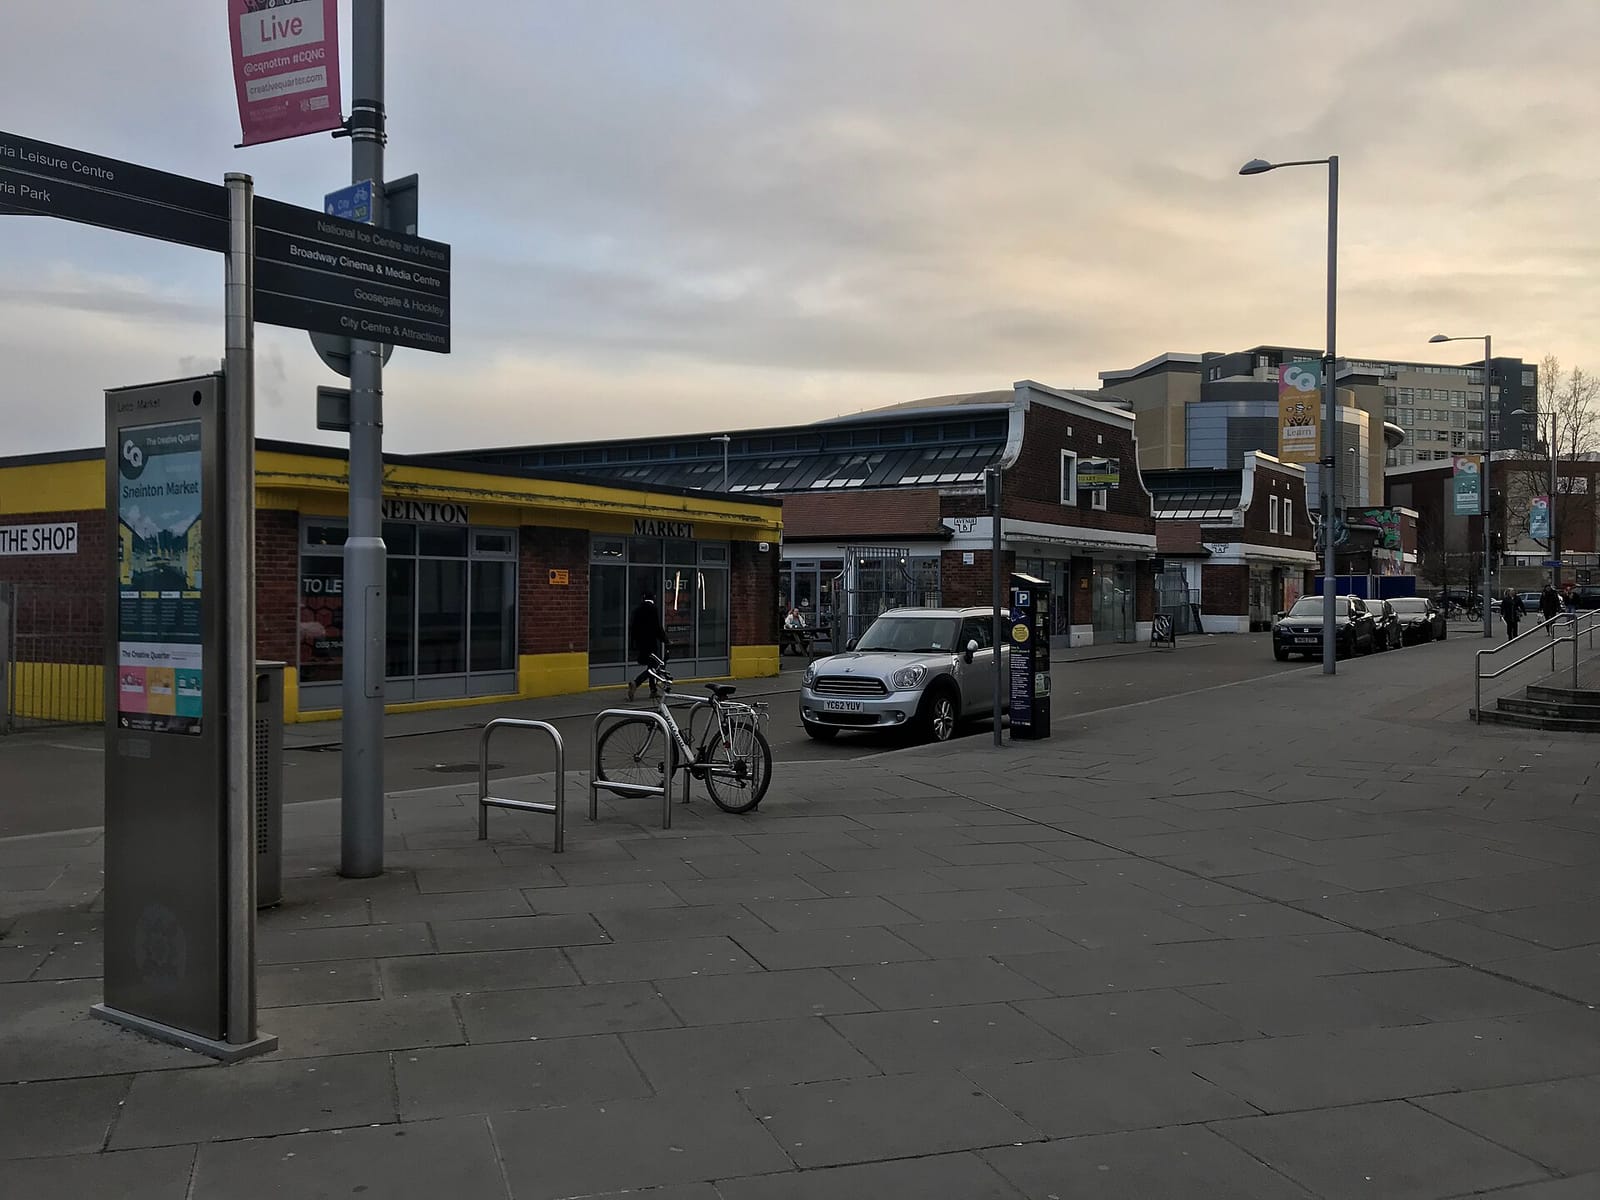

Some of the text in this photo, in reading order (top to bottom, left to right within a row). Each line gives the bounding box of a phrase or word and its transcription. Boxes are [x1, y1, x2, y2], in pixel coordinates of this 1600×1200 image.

[260, 15, 302, 42] Live
[244, 48, 325, 76] @cqnottm #CQNG
[249, 74, 323, 94] creativequarter.com
[0, 144, 115, 180] ria Leisure Centre
[0, 182, 50, 201] ria Park
[317, 221, 445, 260] National Ice Centre and Arena
[290, 245, 441, 287] Broadway Cinema & Media Centre
[354, 289, 445, 317] Goosegate & Hockley
[340, 316, 445, 344] City Centre & Attractions
[1284, 366, 1316, 392] CQ
[147, 438, 156, 446] The
[178, 433, 199, 444] Quarter
[1286, 428, 1312, 437] Learn
[123, 480, 199, 499] Sneinton Market
[382, 500, 469, 523] NEINTON
[634, 519, 694, 538] MARKET
[0, 527, 75, 552] THE SHOP
[303, 578, 343, 593] TO LE
[664, 580, 672, 590] O
[1019, 594, 1027, 604] P
[122, 650, 131, 658] The
[150, 651, 170, 661] Quarter
[826, 700, 860, 710] YC62 YUV
